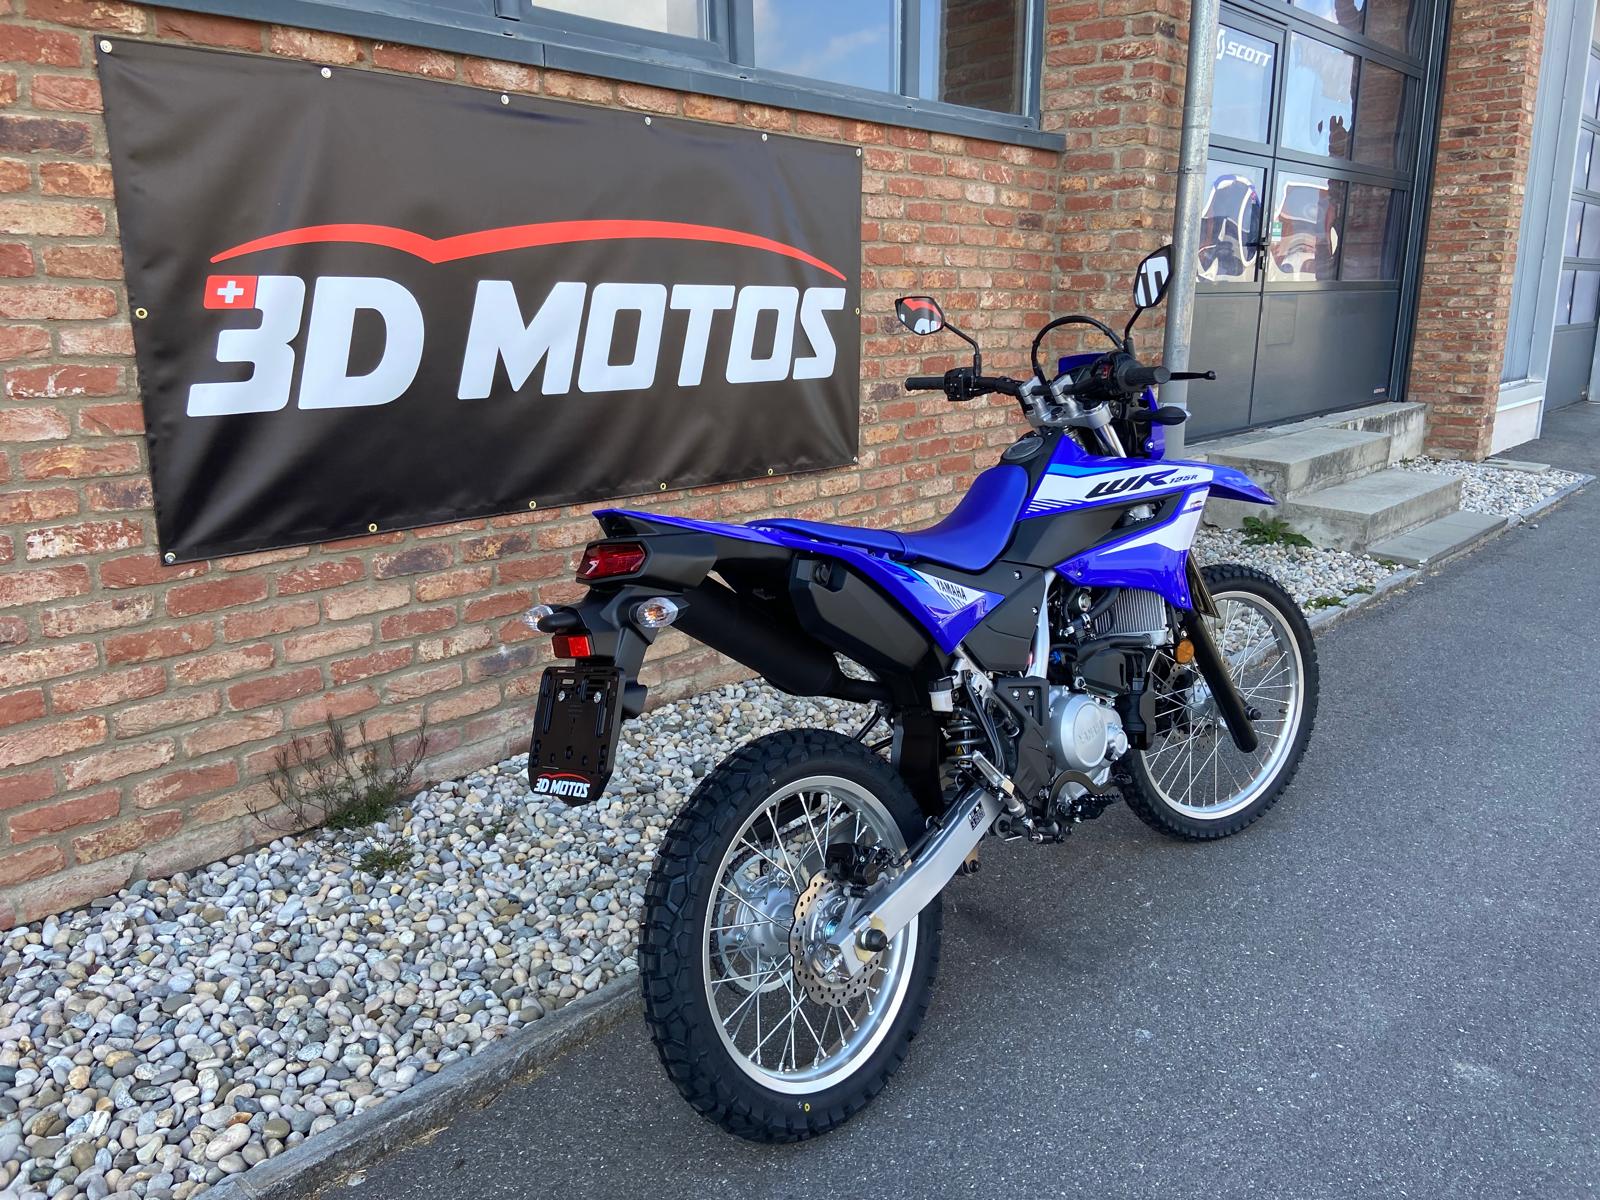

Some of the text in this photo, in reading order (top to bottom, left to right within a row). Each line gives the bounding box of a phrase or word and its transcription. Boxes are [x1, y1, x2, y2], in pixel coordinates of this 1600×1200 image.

[1225, 41, 1272, 67] SCOTT
[186, 275, 847, 417] 3D MOTOS
[1084, 468, 1199, 499] WR 125R
[933, 578, 968, 601] YAMAHA
[533, 777, 591, 798] 3D MOTOS
